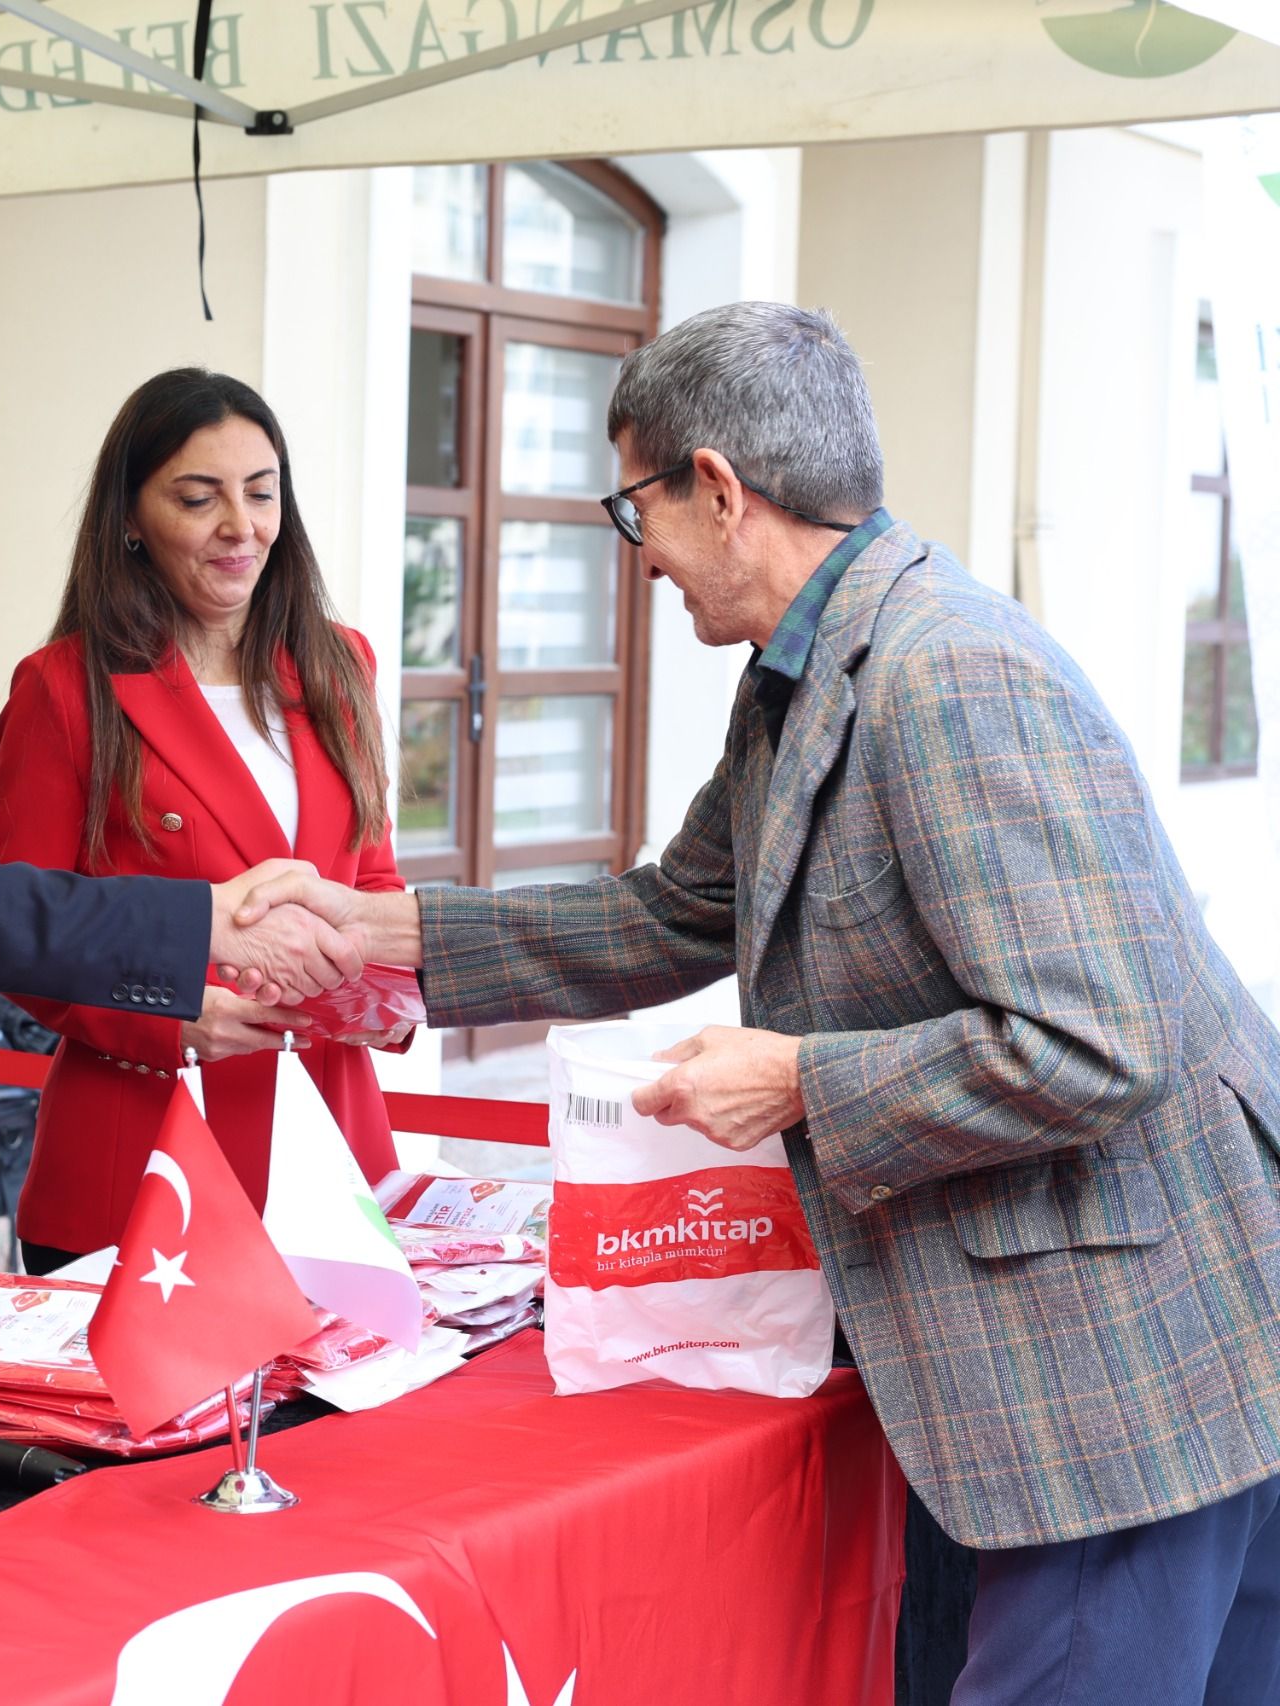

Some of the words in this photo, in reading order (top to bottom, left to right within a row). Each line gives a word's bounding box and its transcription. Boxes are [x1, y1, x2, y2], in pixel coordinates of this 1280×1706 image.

[596, 1216, 773, 1256] bkmkitap
[597, 1261, 616, 1272] bir
[619, 1251, 662, 1270] kitapla
[665, 1245, 727, 1259] mümkün!
